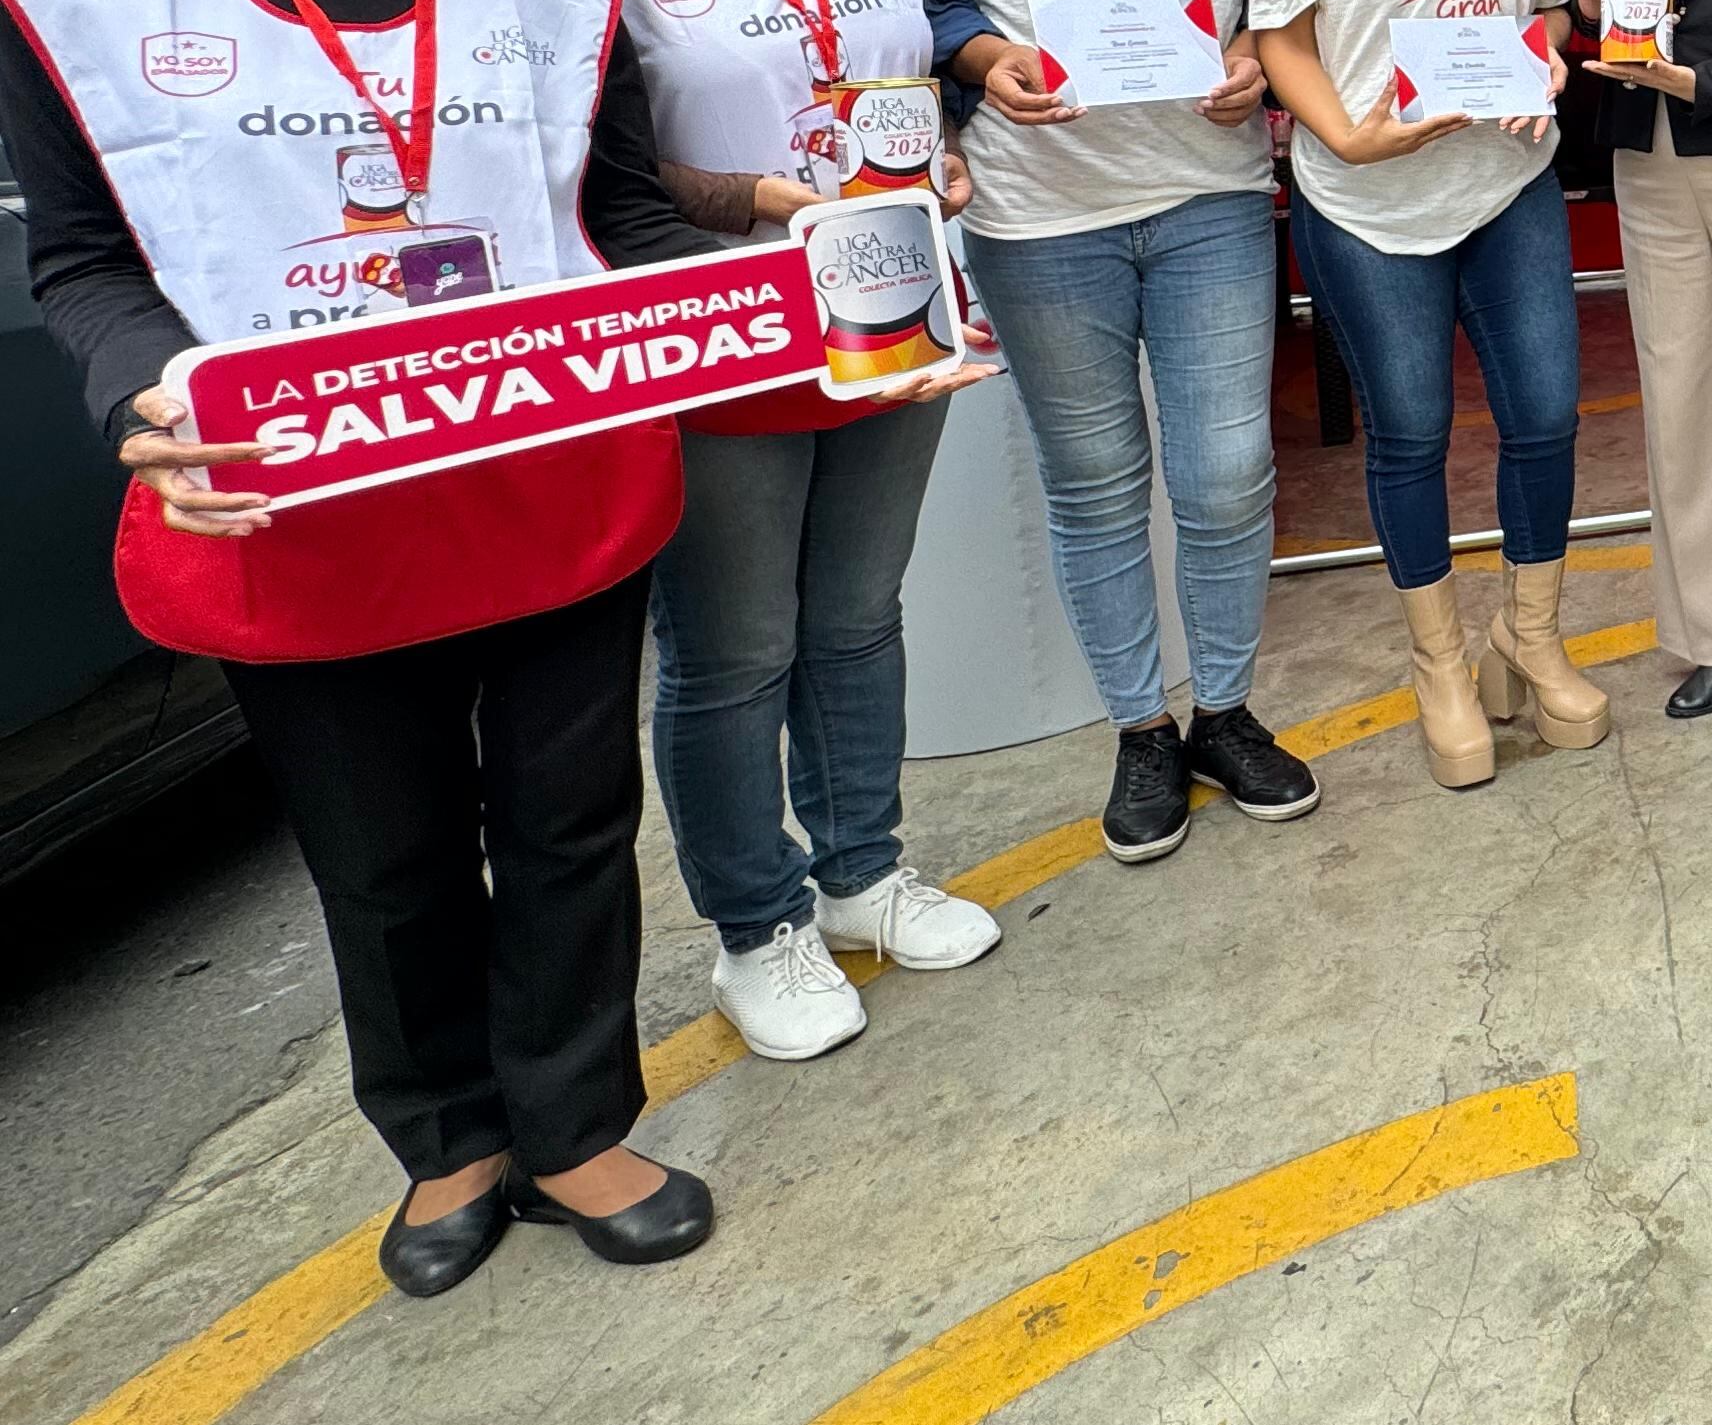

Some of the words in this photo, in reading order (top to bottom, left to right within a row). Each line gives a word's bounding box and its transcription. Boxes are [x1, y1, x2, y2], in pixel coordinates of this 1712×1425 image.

[1623, 5, 1660, 20] 2024
[151, 55, 180, 66] YO
[184, 56, 227, 67] SOY
[871, 97, 905, 111] LIGA
[872, 108, 919, 119] CONTRA
[884, 136, 932, 157] 2024
[834, 231, 882, 254] LIGA
[837, 243, 906, 267] CONTRA
[908, 242, 918, 254] el
[858, 280, 897, 294] COLECTA
[252, 312, 272, 331] a
[242, 379, 303, 412] LA
[315, 323, 565, 397] DETECCIÓN
[572, 282, 784, 342] TEMPRANA
[255, 374, 554, 467] SALVA
[563, 312, 792, 393] VIDAS
